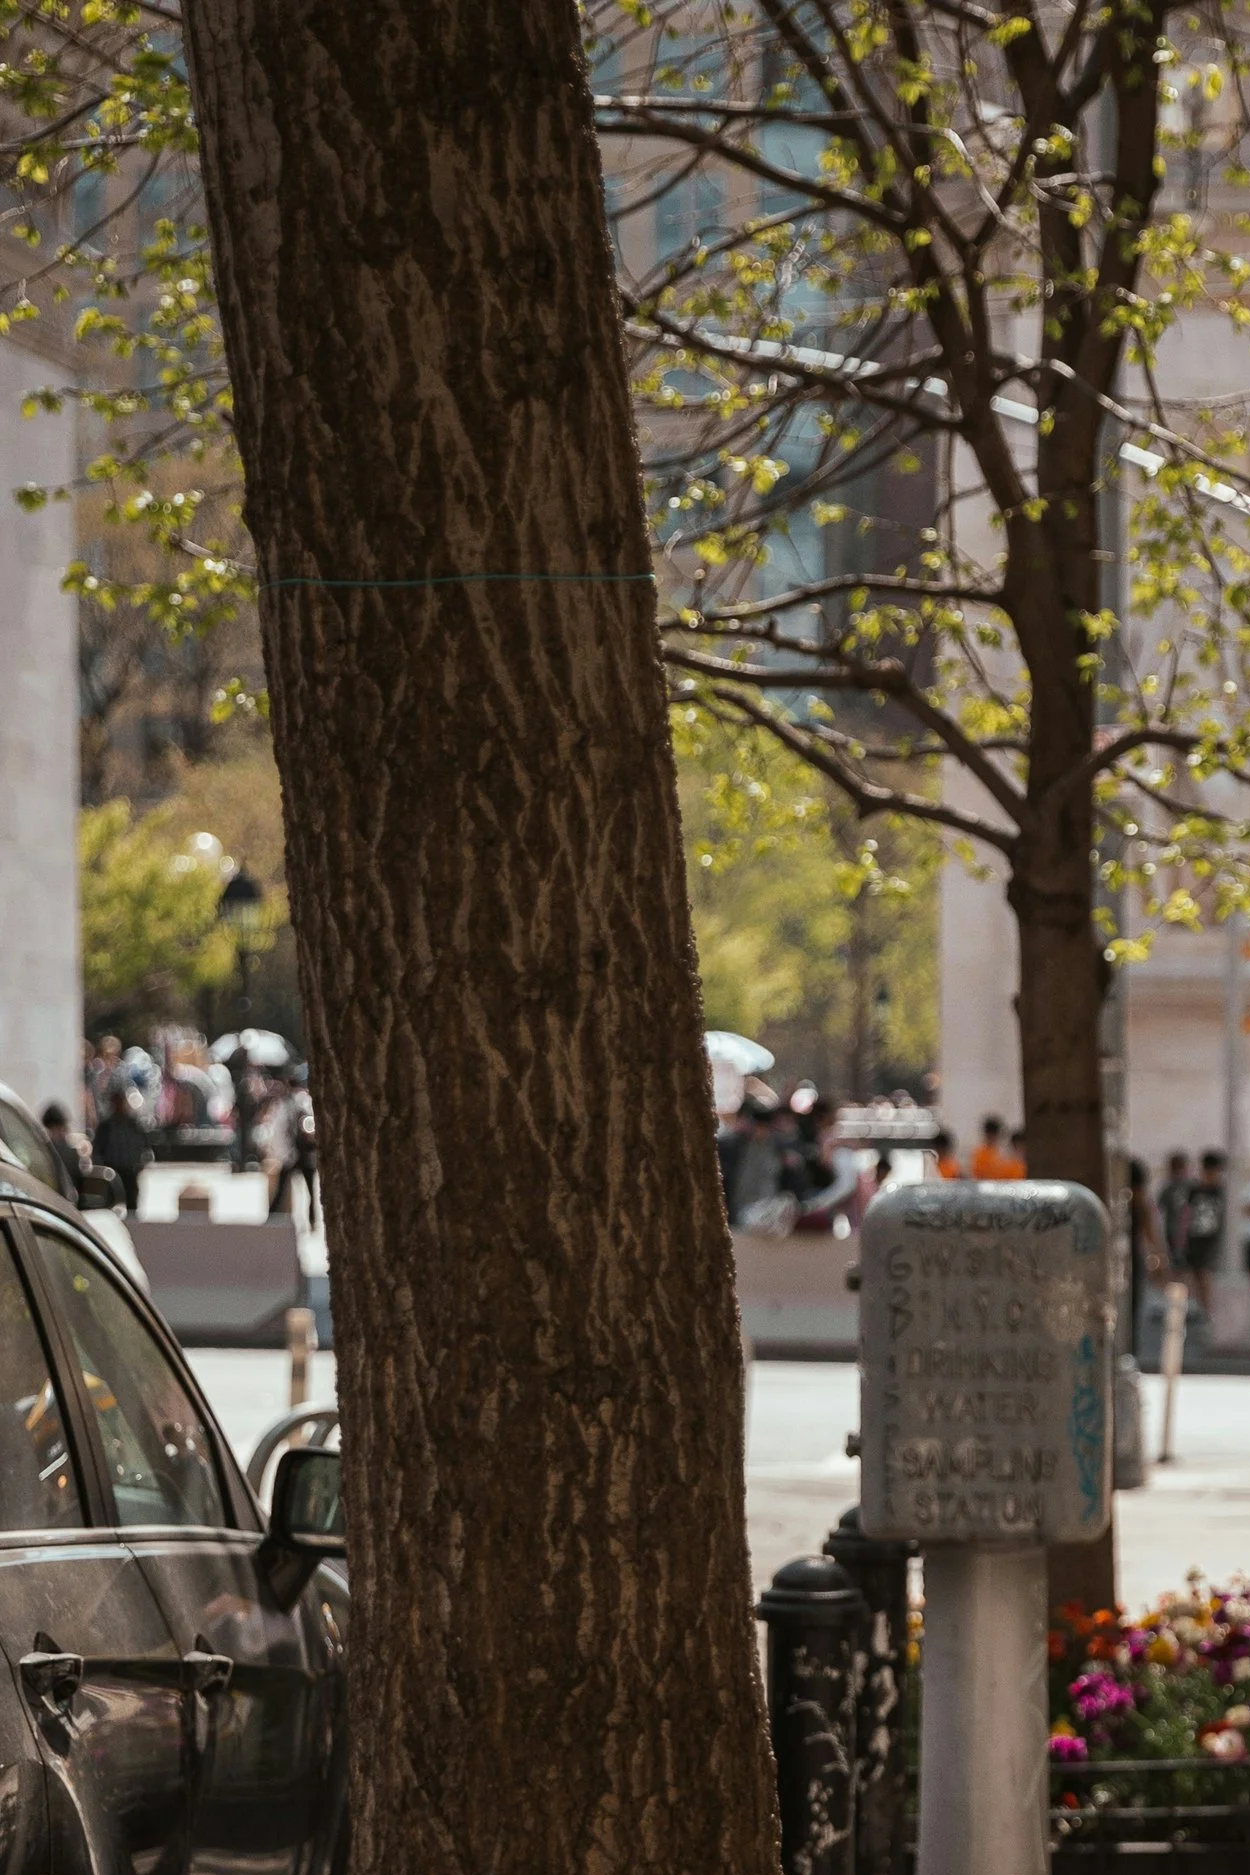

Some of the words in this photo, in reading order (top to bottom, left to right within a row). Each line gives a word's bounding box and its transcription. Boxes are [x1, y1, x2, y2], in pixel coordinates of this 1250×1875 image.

[905, 1347, 1058, 1383] DRINKING
[921, 1390, 1039, 1424] WATER
[903, 1447, 1059, 1483] SAMPLING
[915, 1491, 1044, 1526] STATION
